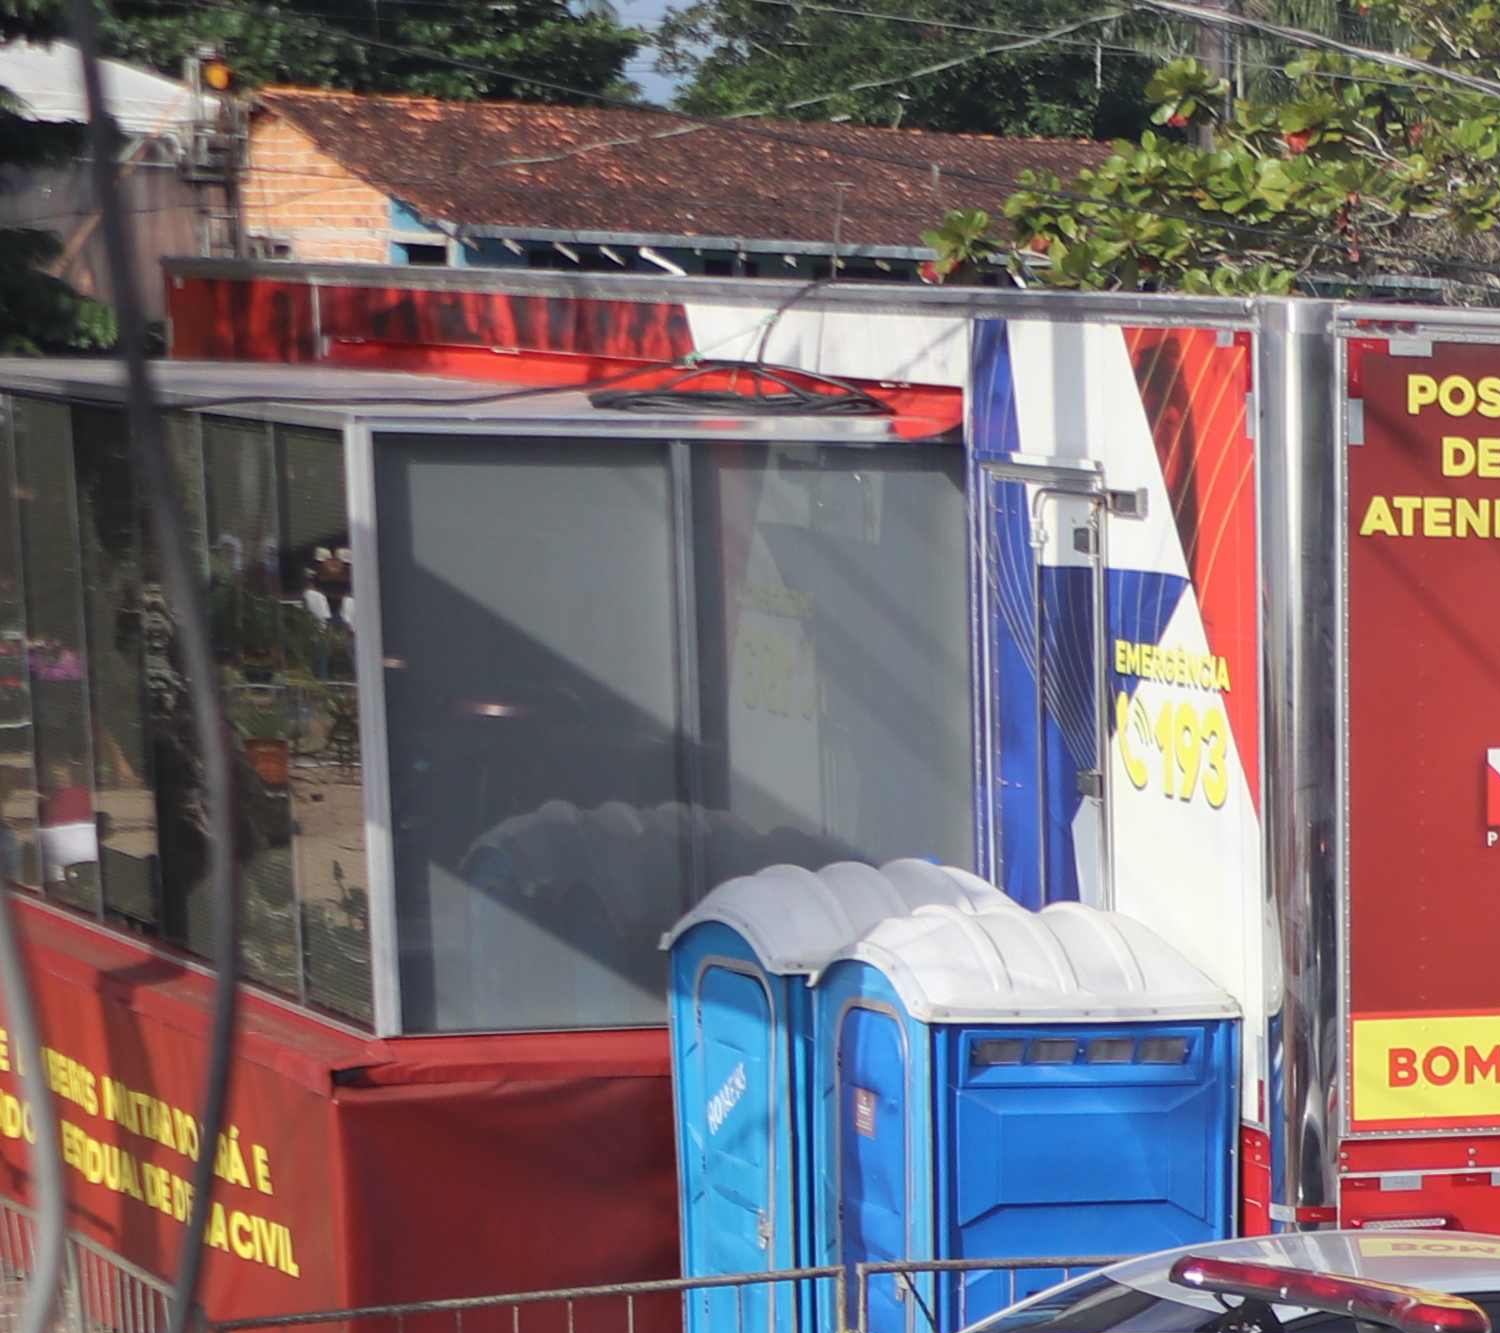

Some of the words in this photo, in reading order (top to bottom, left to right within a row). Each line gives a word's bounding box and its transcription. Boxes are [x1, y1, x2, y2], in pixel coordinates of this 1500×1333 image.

[1114, 638, 1231, 692] EMERGÊNCIA
[1153, 701, 1229, 810] 193
[251, 1143, 274, 1196] E
[228, 1209, 300, 1279] CIVIL
